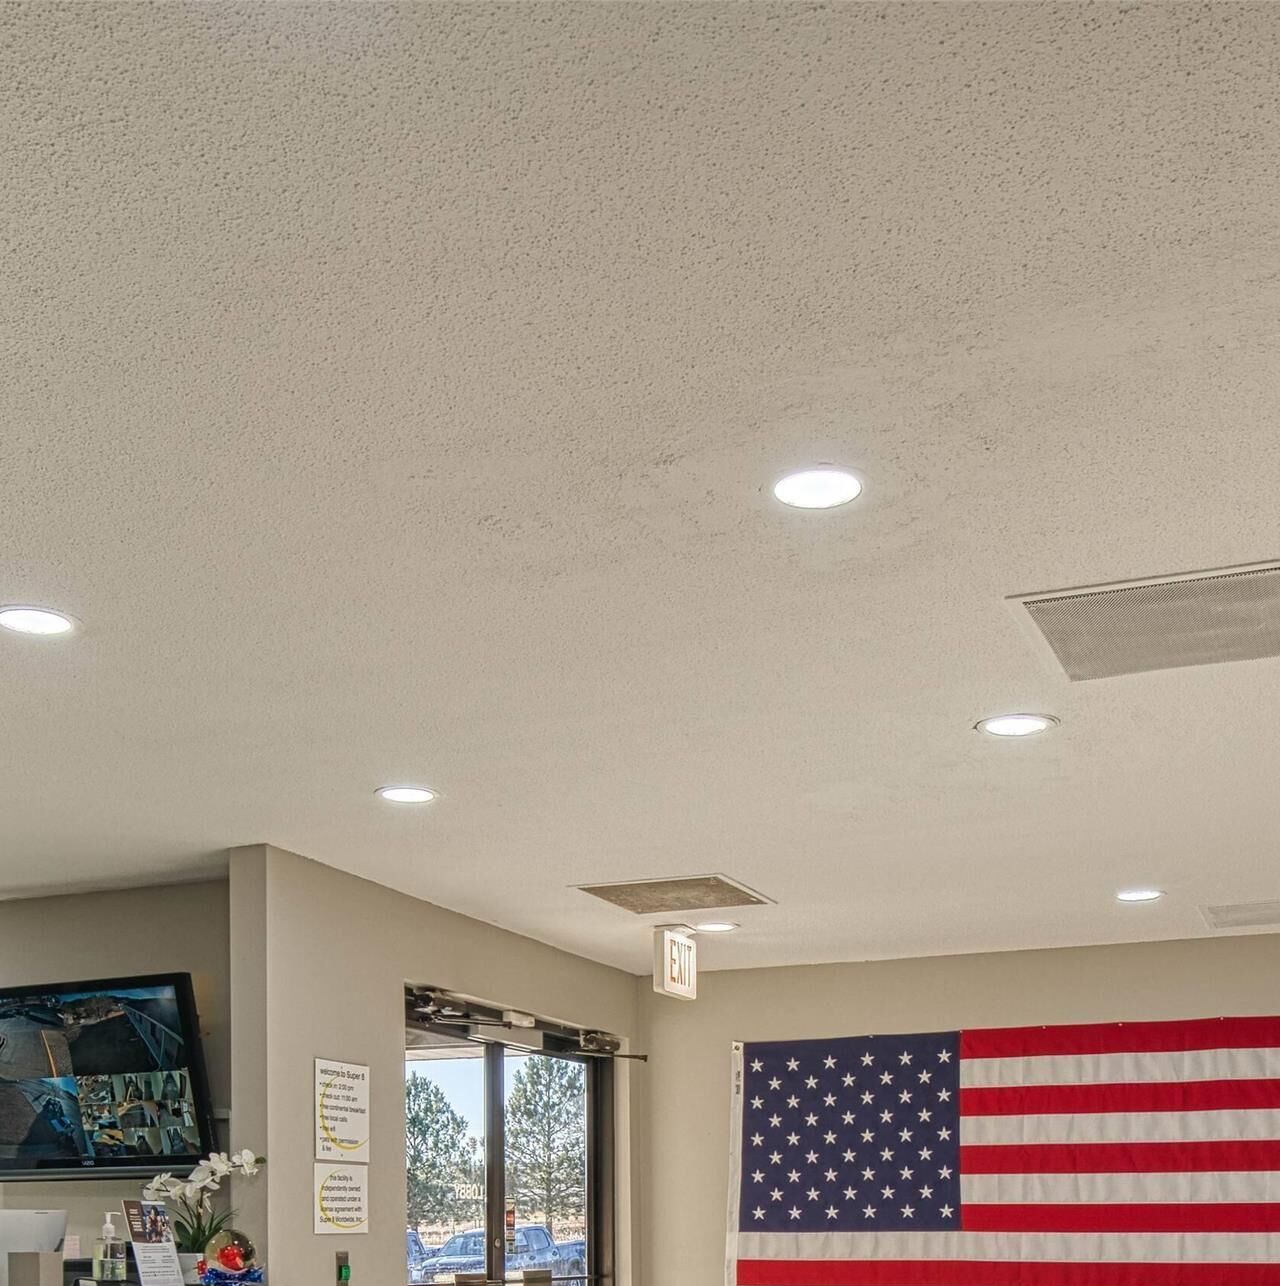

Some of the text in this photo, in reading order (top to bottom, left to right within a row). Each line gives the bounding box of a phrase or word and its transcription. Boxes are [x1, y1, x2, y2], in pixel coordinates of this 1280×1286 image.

[670, 939, 692, 987] EXIT
[320, 1069, 340, 1077] welcome
[346, 1070, 361, 1080] Super
